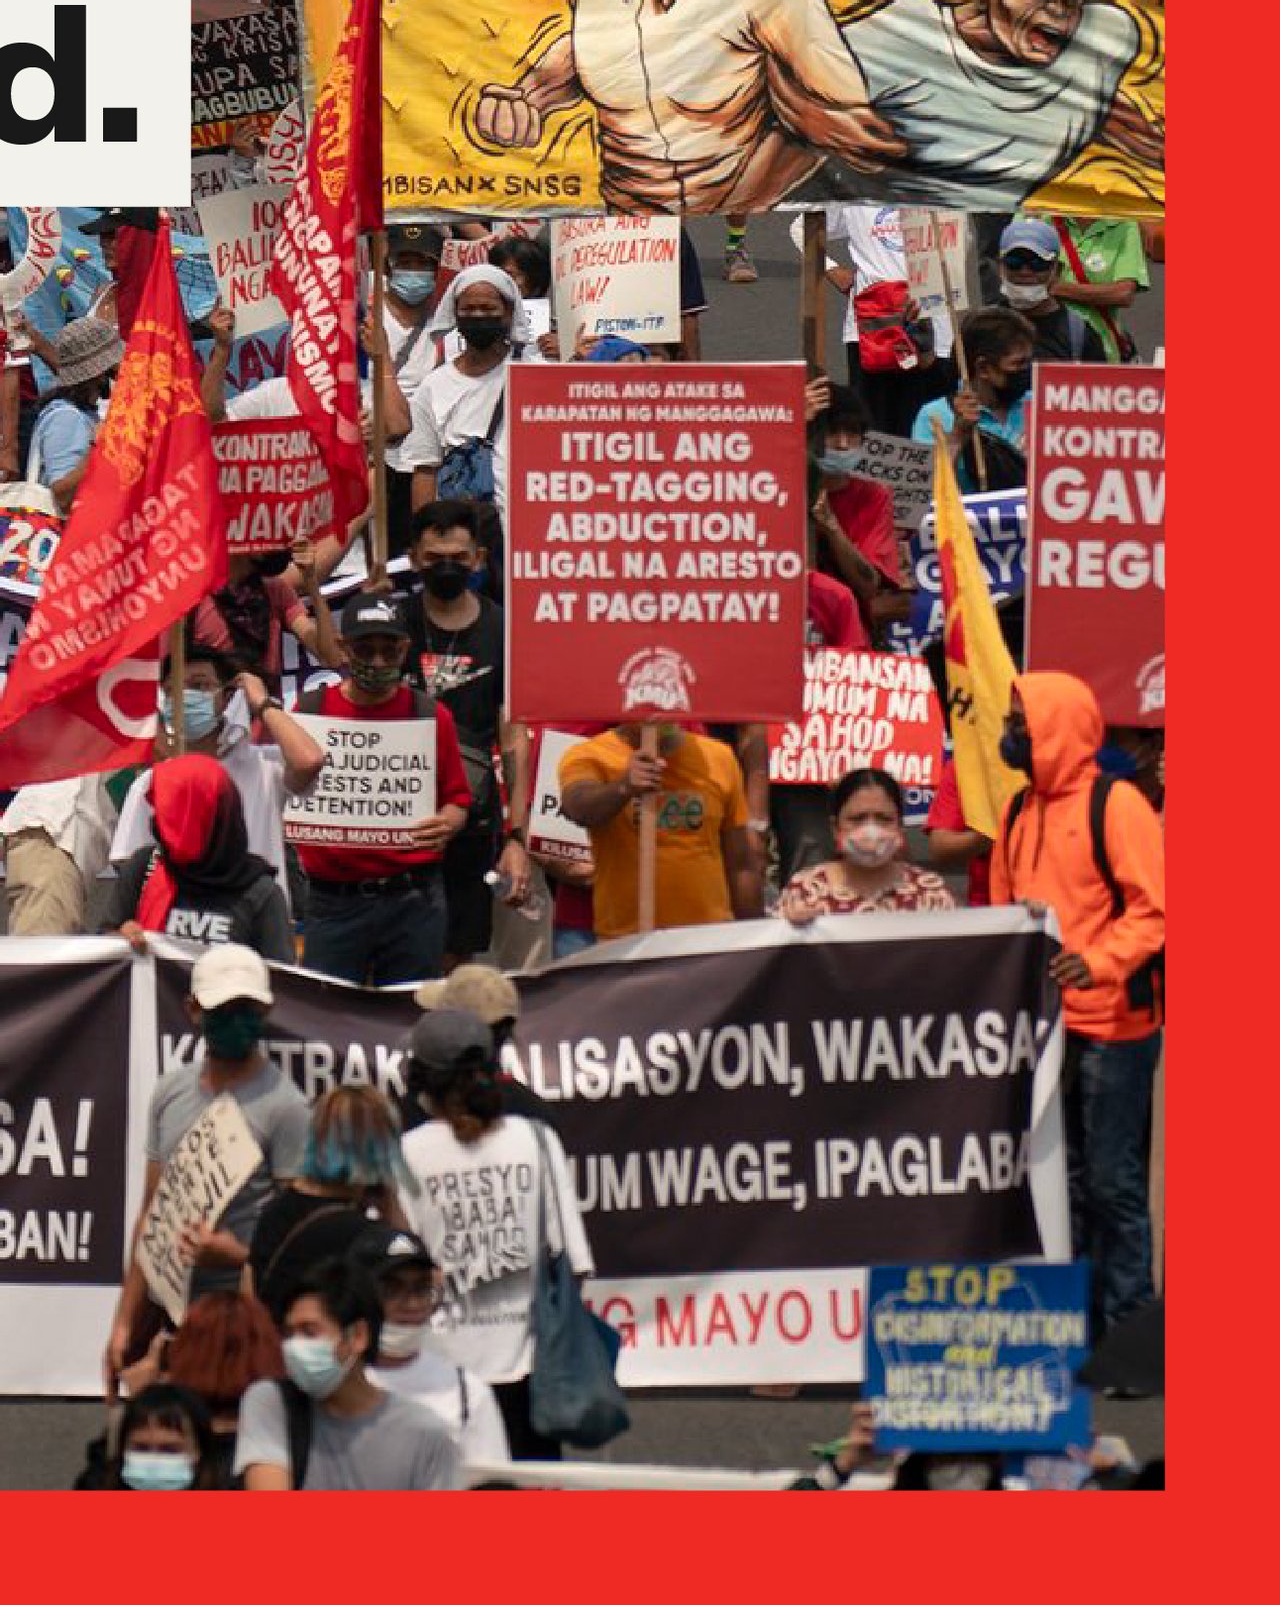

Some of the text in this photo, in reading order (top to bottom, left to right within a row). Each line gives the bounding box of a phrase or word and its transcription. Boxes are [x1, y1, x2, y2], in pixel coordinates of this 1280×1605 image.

[568, 382, 745, 400] ITIGIL ANG ATAKE SA
[522, 405, 793, 423] KARAPATAN NG MANGGAGAWA:
[561, 431, 753, 462] ITIGIL ANG
[526, 471, 789, 508] RED-TAGGING,
[546, 512, 767, 548] ABDUCTION,
[513, 550, 801, 580] ILIGAL NA ARESTO
[534, 592, 780, 623] AT PAGPATAY!
[888, 692, 928, 723] NA
[328, 730, 381, 749] STOP
[782, 713, 894, 755] SAHOD
[378, 775, 422, 793] AND
[289, 797, 413, 818] DETENTION!
[353, 827, 403, 844] MAYO
[649, 1140, 807, 1211] WAGE,
[905, 1266, 1015, 1306] STOP
[655, 1288, 814, 1347] MAYO
